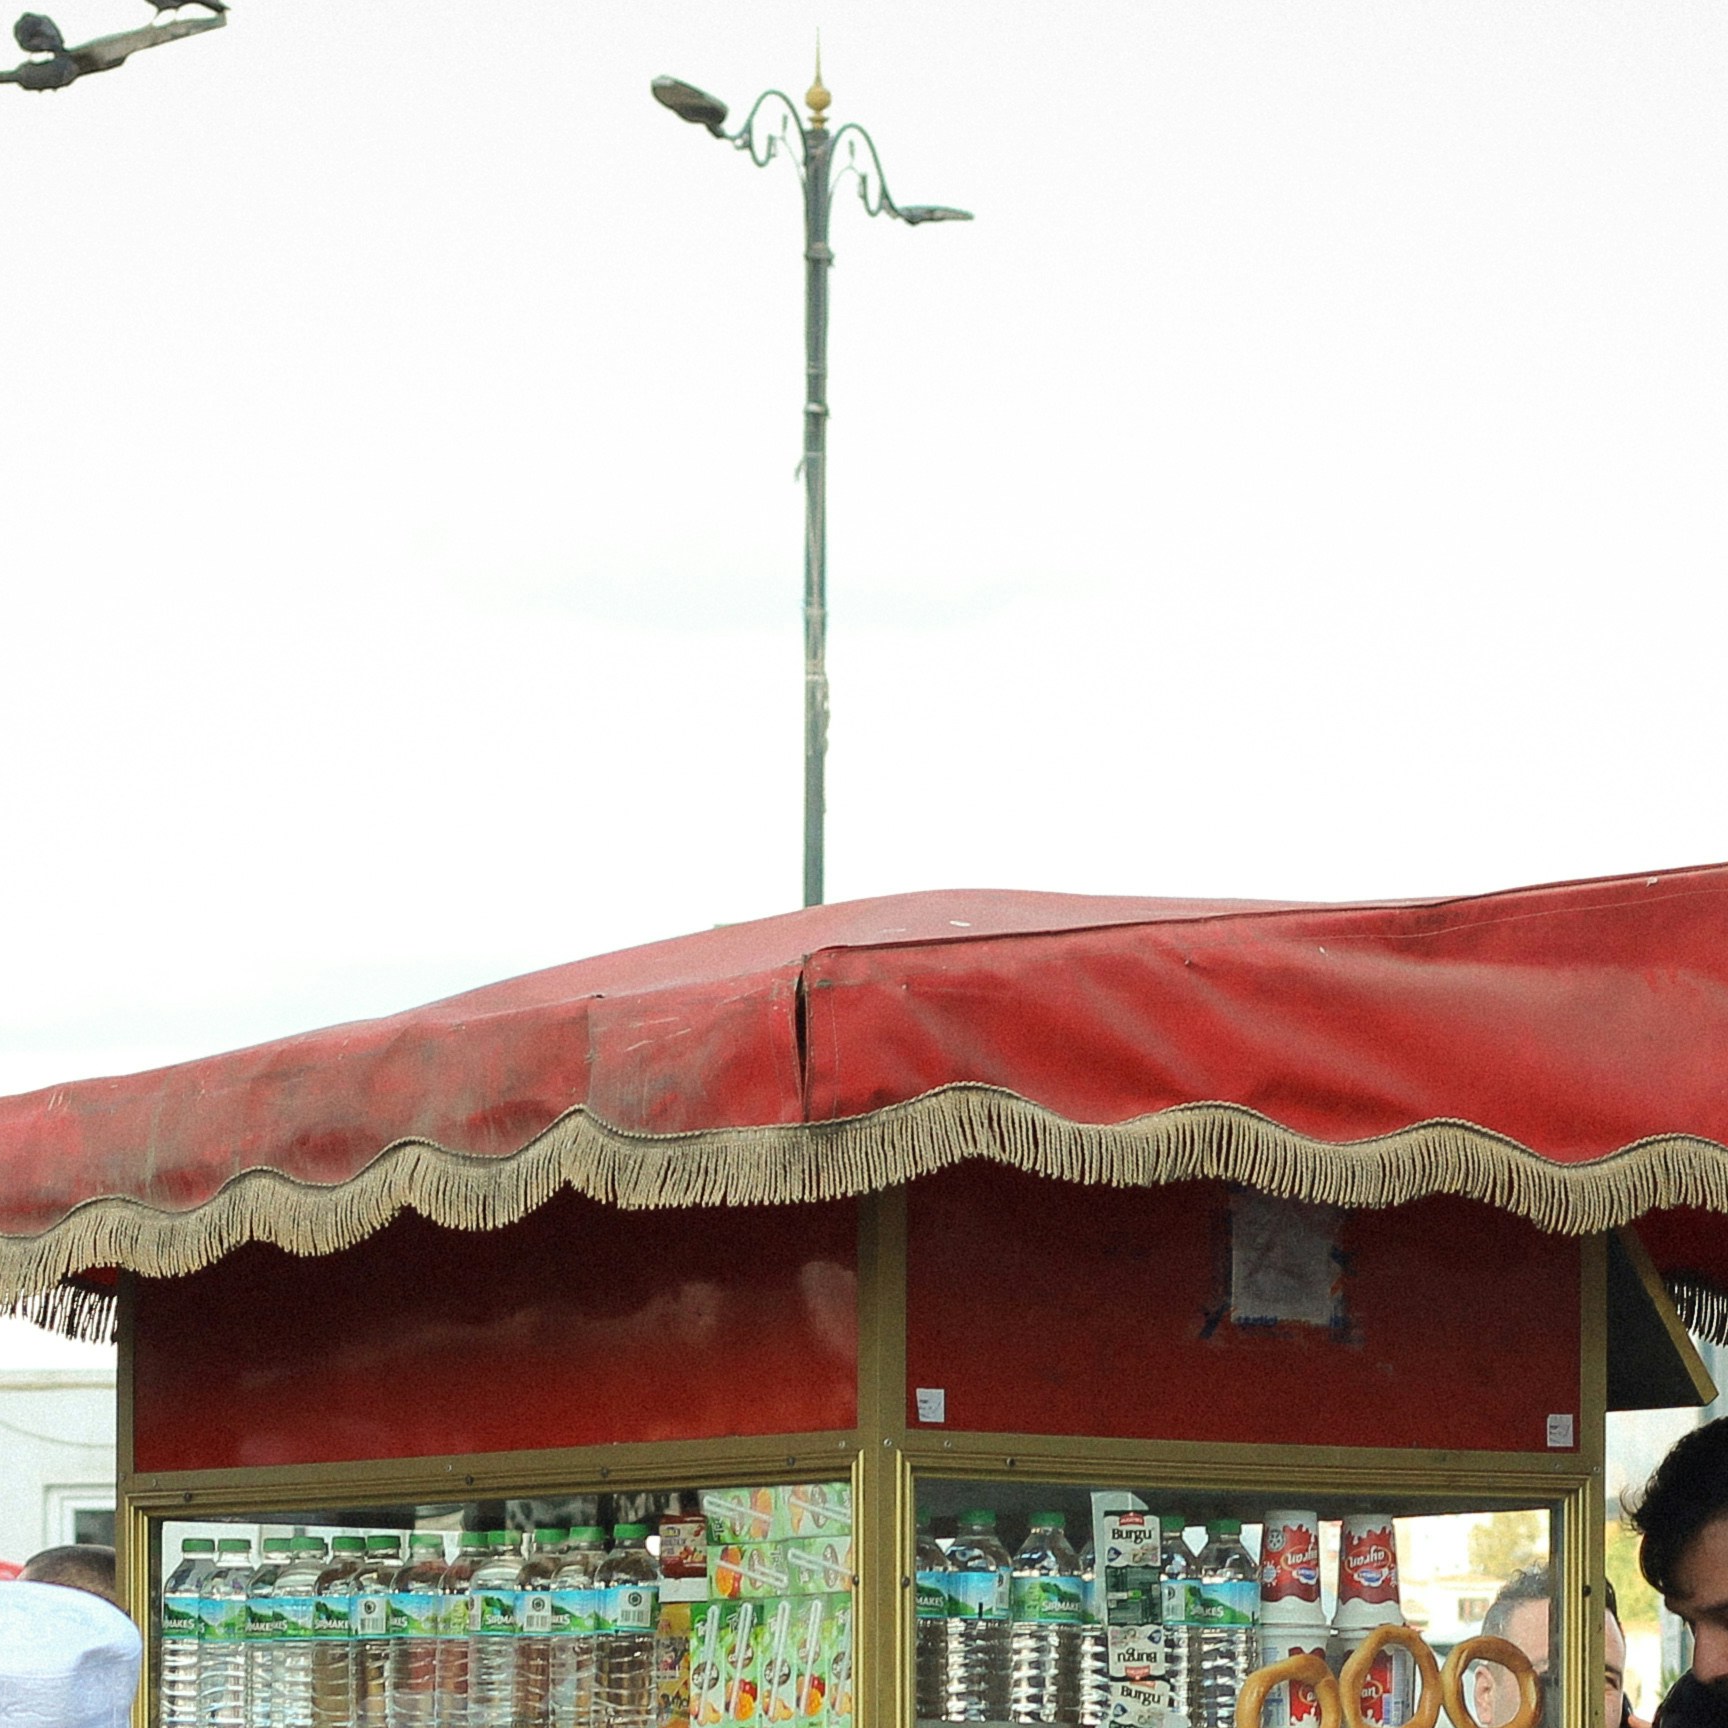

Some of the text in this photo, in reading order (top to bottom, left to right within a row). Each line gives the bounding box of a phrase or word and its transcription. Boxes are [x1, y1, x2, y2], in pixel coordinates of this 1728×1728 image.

[1111, 1528, 1152, 1544] Burgu
[1349, 1544, 1385, 1568] ayran
[1117, 1648, 1158, 1664] Burgu
[1120, 1685, 1162, 1706] Burgu
